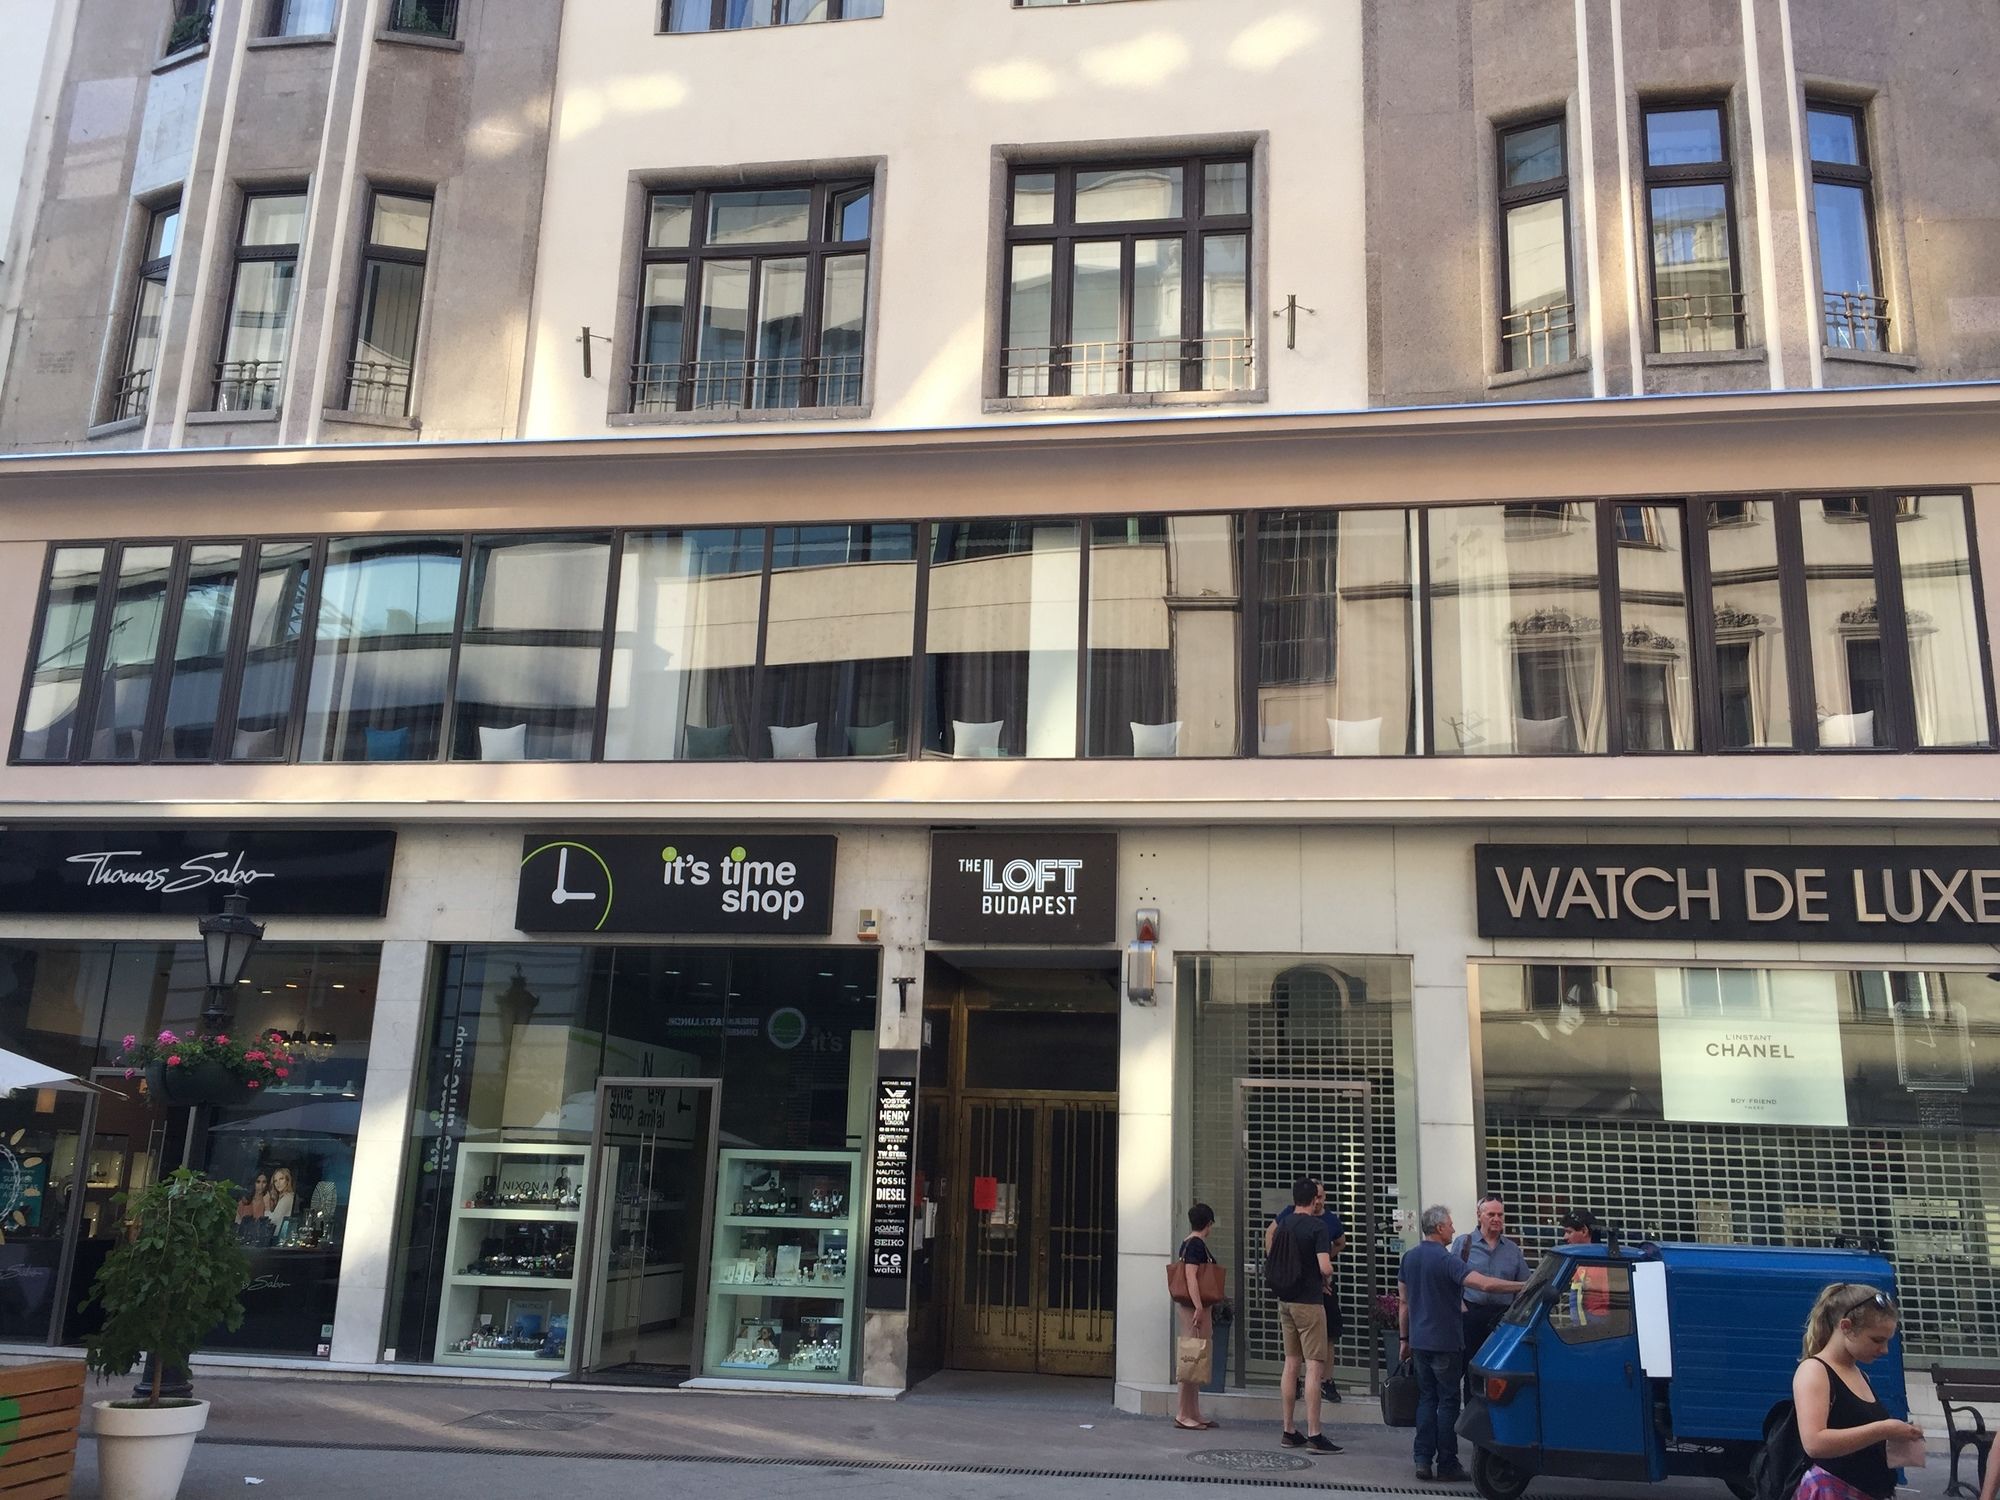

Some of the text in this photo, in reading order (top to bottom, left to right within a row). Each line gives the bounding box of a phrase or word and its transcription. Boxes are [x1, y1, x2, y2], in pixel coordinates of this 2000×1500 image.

[66, 850, 275, 893] Thomas Sabo
[662, 846, 797, 887] it's time
[958, 858, 1084, 893] THE LOFT
[1494, 866, 2000, 924] WATCH DE LUXE
[721, 887, 805, 921] shop
[982, 895, 1078, 915] BUDAPEST
[1725, 1033, 1773, 1042] L'INSTANT
[1705, 1043, 1795, 1059] CHANEL
[1749, 1097, 1778, 1105] FRIEND
[879, 1110, 910, 1121] HENRY
[502, 1181, 540, 1191] NIXON
[876, 1187, 906, 1201] DIESEL
[875, 1225, 904, 1233] ROAMER
[874, 1248, 902, 1265] ice
[248, 1273, 291, 1291] Sabo
